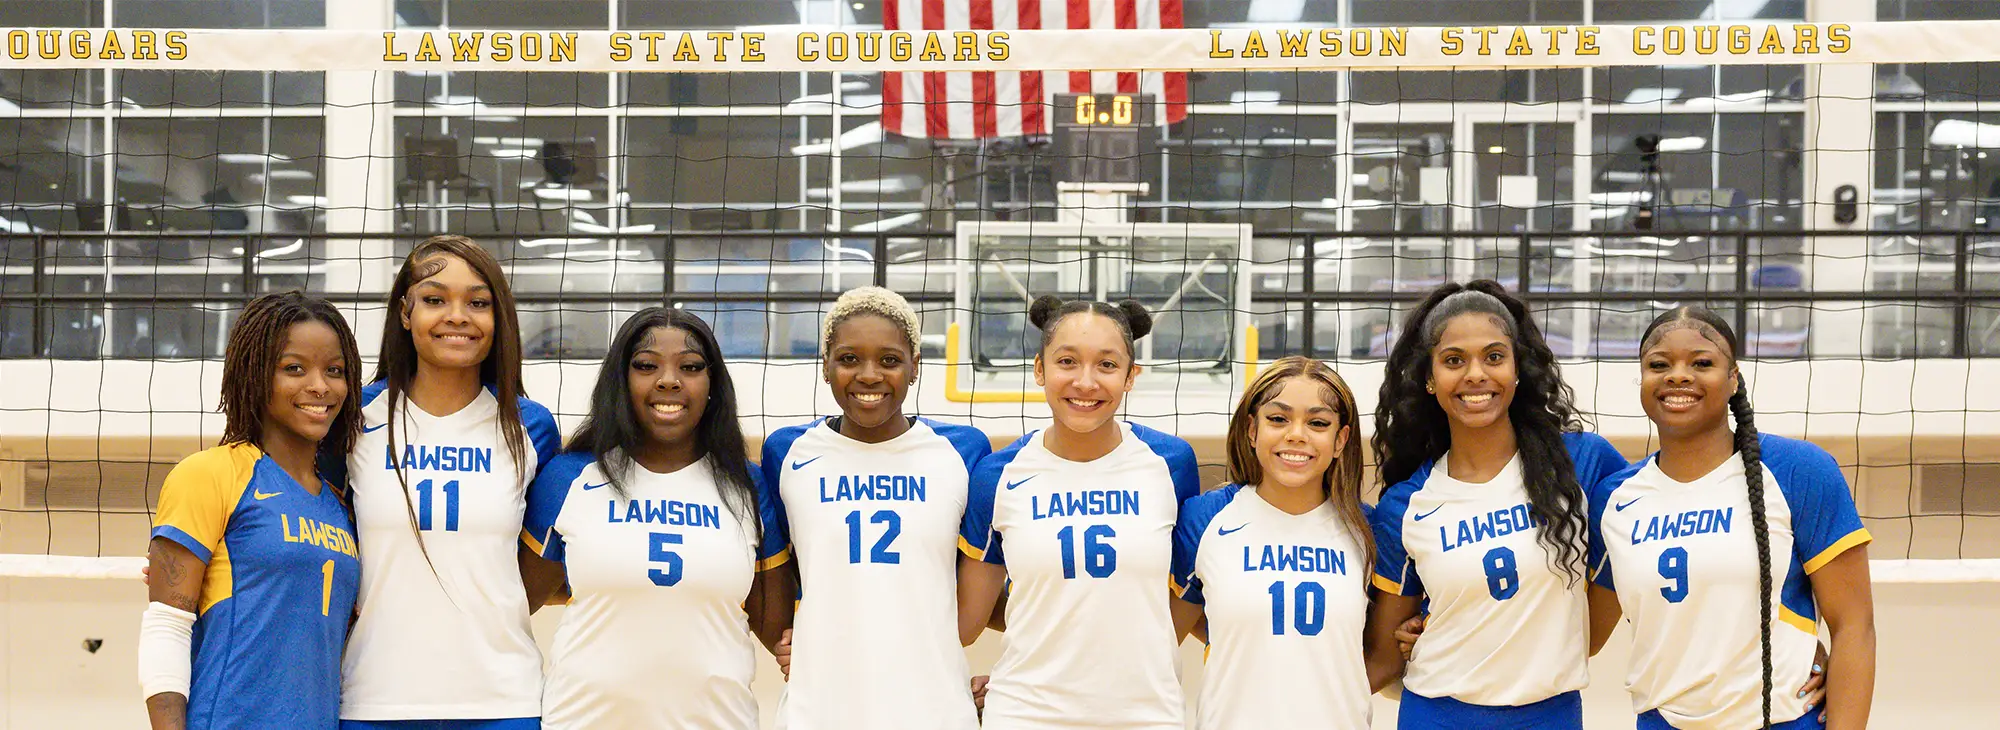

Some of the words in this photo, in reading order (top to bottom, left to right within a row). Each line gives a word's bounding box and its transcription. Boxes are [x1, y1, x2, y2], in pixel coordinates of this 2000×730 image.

[0, 29, 189, 60] OUGARS
[383, 31, 578, 62] LAWSON
[609, 32, 766, 62] STATE
[796, 31, 1011, 62] COUGARS
[1209, 28, 1408, 59] LAWSON
[1440, 26, 1601, 57] STATE
[1632, 23, 1853, 56] COUGARS
[1076, 95, 1133, 125] 0.0
[385, 444, 492, 473] LAWSON
[416, 479, 460, 531] 11
[820, 475, 926, 503] LAWSON
[1031, 490, 1140, 521] LAWSON
[608, 499, 721, 529] LAWSON
[1631, 507, 1734, 545] LAWSON
[280, 513, 360, 561] LAWSON
[845, 510, 901, 564] 12
[1057, 525, 1117, 579] 16
[647, 532, 683, 587] 5
[1243, 544, 1347, 576] LAWSON
[1482, 546, 1520, 601] 8
[1657, 547, 1689, 603] 9
[321, 559, 335, 617] 1
[1268, 580, 1326, 636] 10
